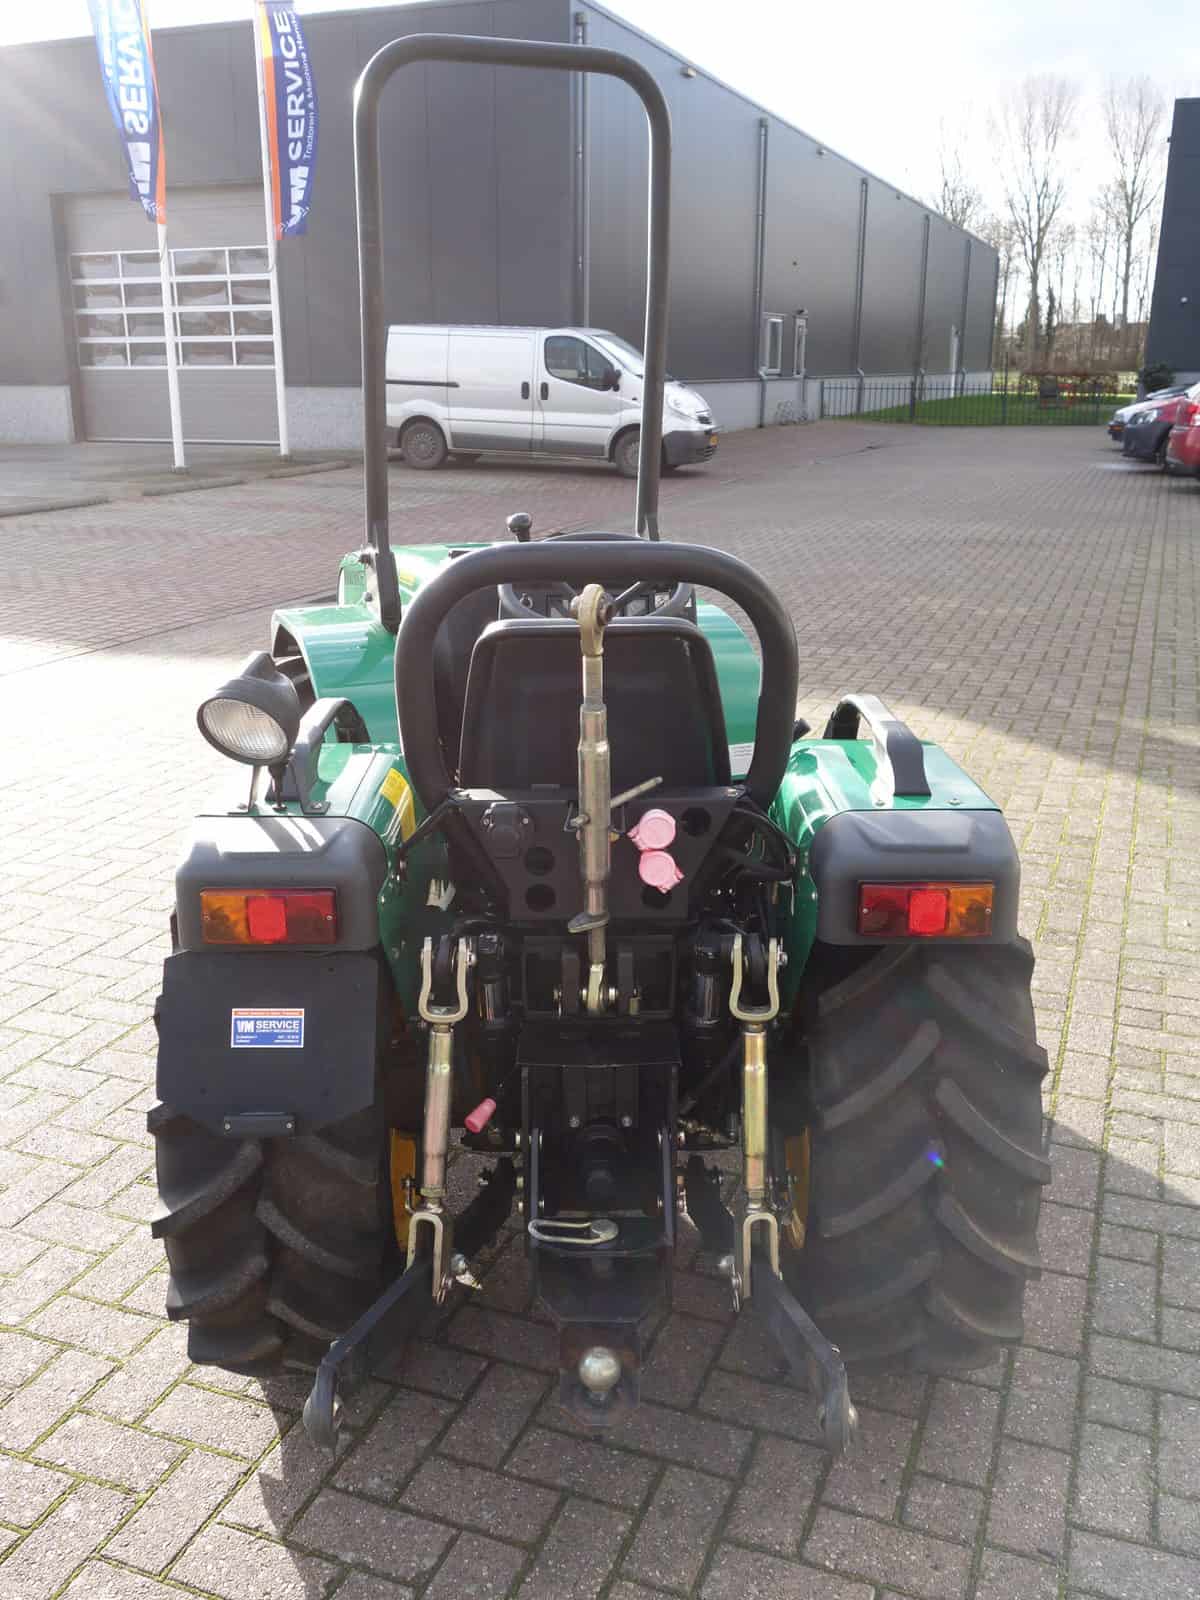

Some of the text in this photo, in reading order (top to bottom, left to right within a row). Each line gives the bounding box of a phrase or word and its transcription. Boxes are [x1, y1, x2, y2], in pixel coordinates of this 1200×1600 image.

[272, 10, 305, 161] SERVICE
[302, 111, 315, 160] Tractoren
[255, 1020, 300, 1029] SERVICE
